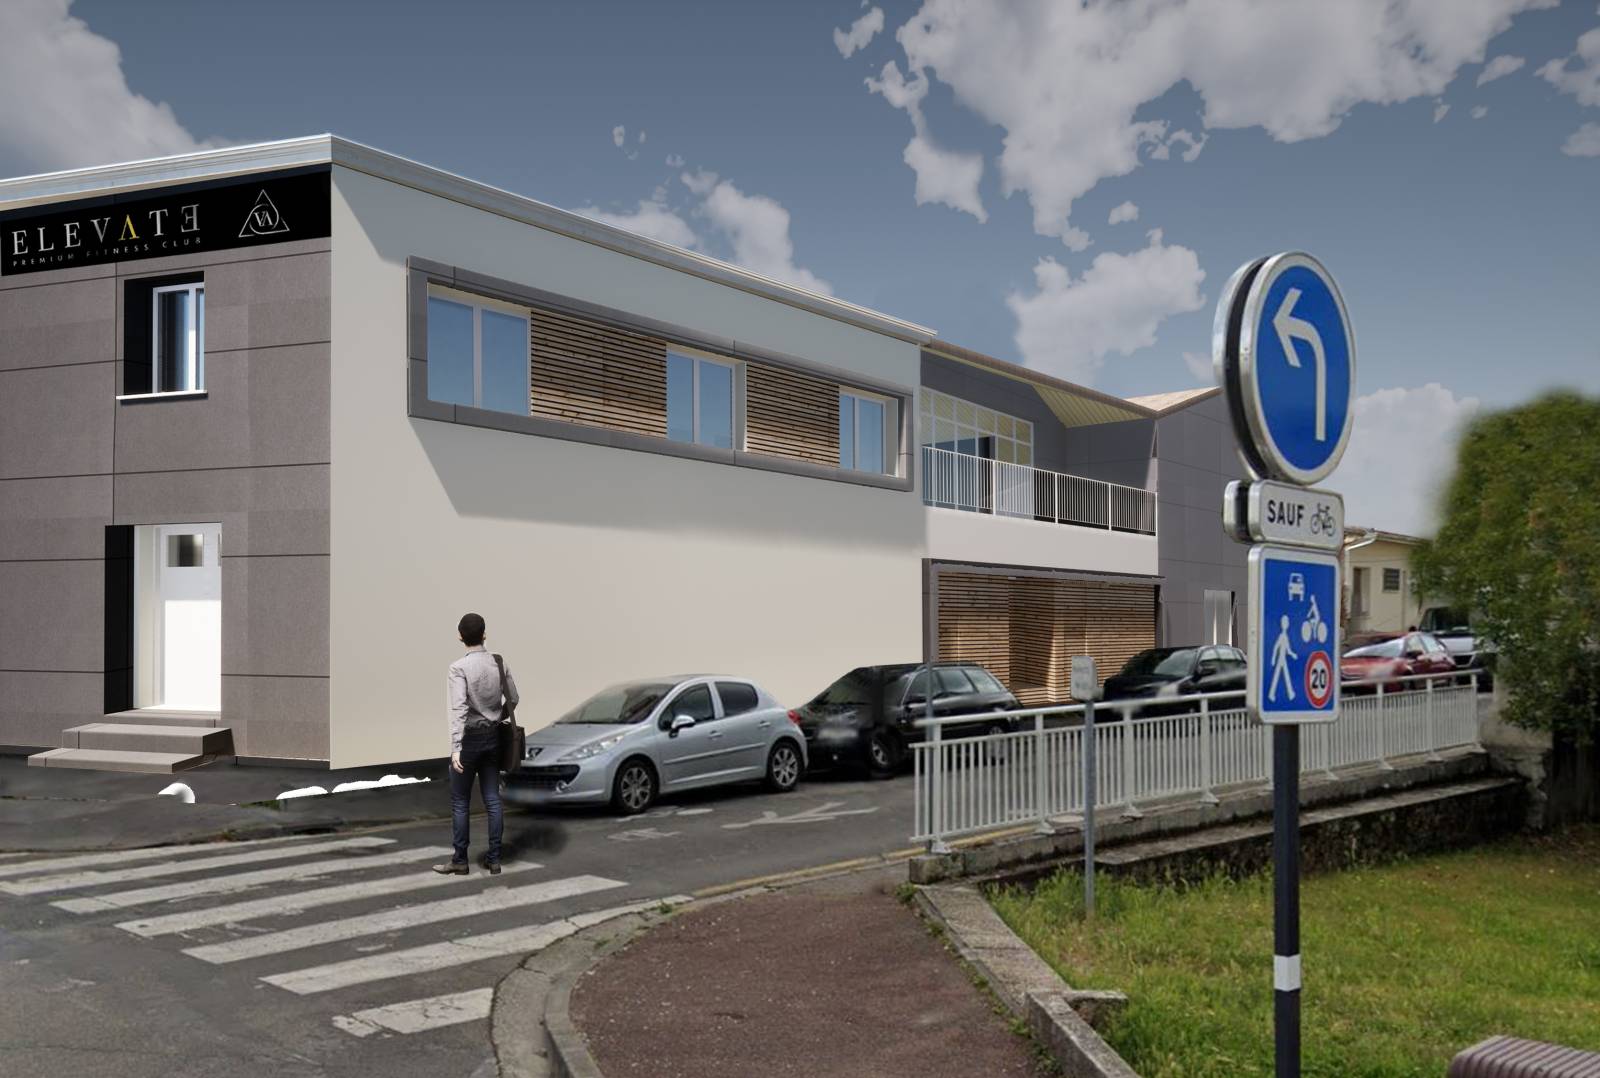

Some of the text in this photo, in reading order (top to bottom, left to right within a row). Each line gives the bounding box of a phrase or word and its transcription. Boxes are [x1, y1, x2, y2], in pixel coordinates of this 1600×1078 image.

[12, 237, 201, 267] PREMIUM FITNESS CLUB
[1267, 499, 1305, 527] SAUF
[1311, 668, 1327, 690] 20
